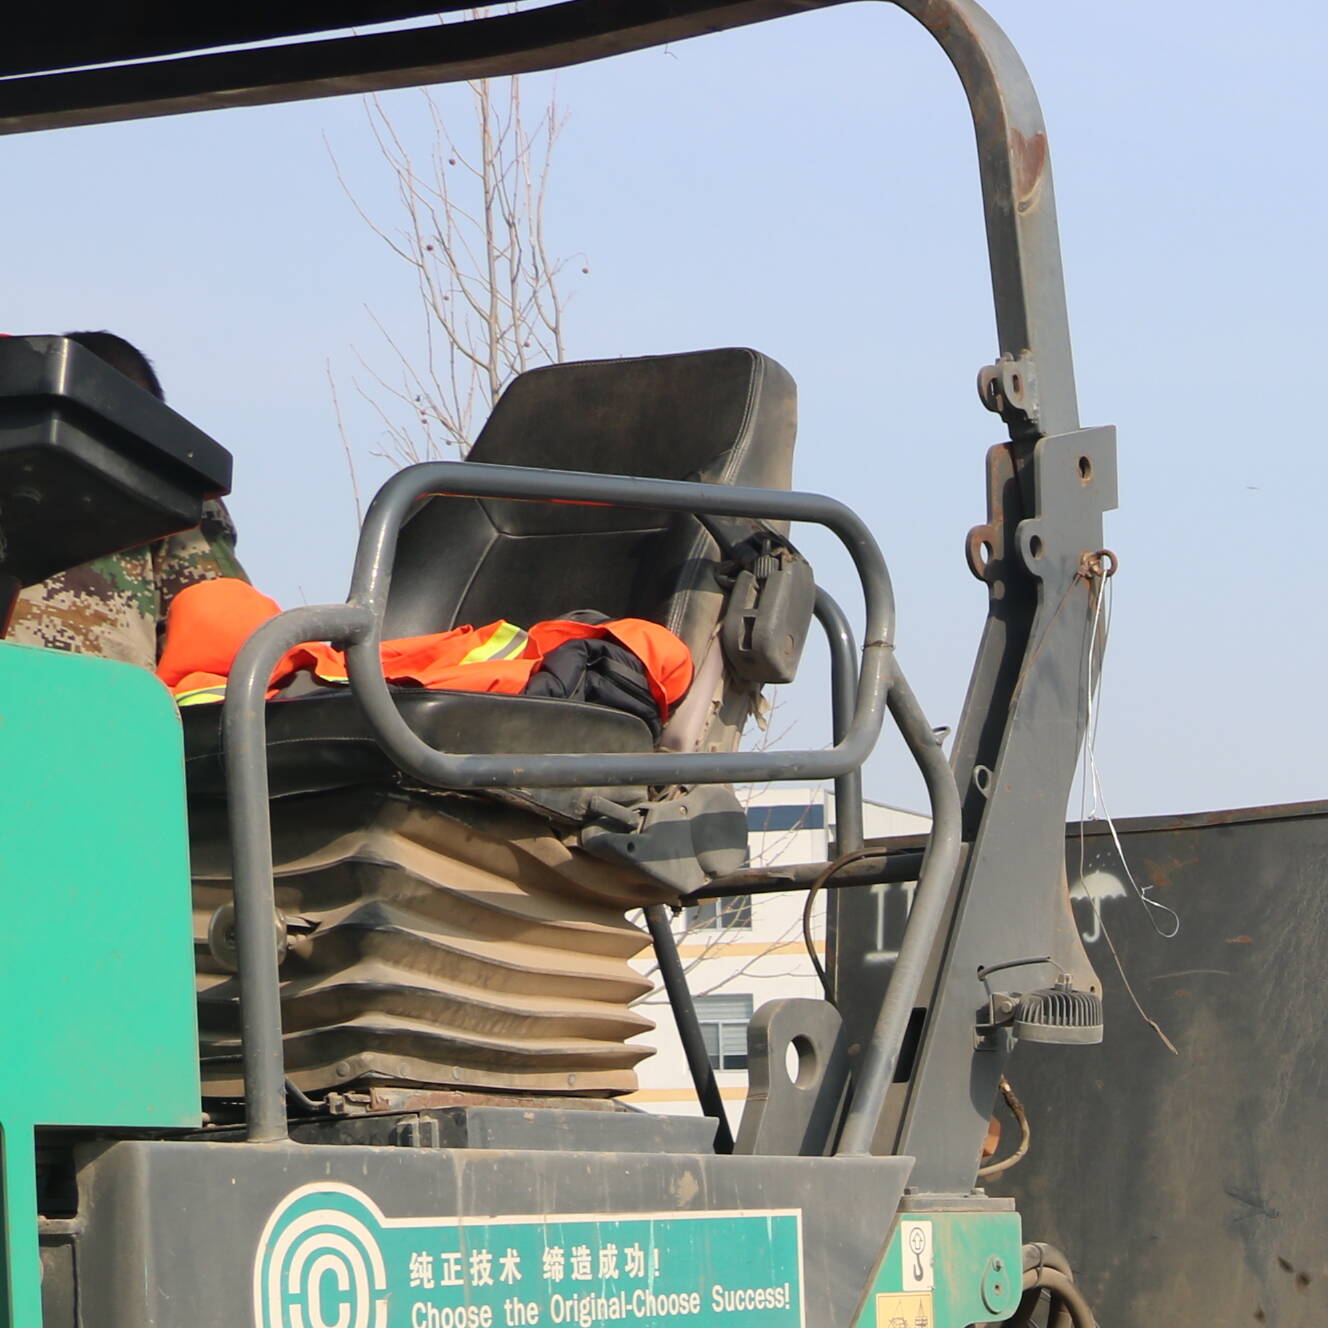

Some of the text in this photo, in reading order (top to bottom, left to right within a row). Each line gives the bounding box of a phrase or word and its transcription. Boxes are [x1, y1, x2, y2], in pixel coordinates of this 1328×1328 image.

[409, 1248, 522, 1289] 纯正技术
[504, 1297, 539, 1327] the
[550, 1290, 700, 1328] Original-Choose
[712, 1282, 790, 1313] Success!
